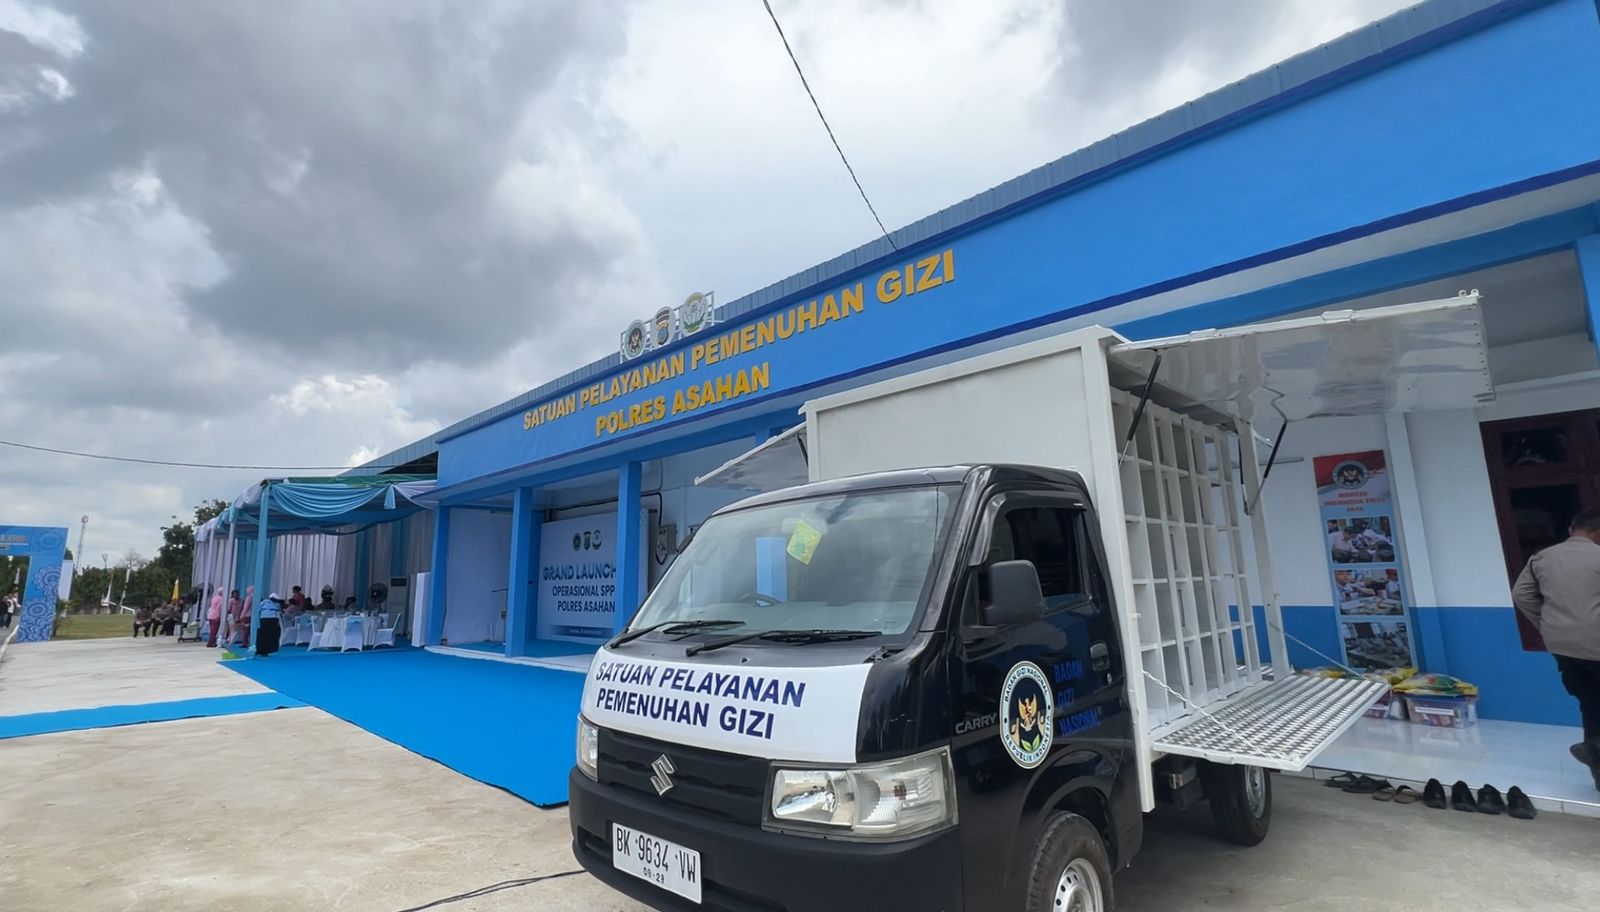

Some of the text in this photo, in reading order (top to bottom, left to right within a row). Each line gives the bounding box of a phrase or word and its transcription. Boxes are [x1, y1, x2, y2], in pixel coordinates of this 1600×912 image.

[523, 393, 577, 431] SATUAN
[580, 351, 685, 410] PELAYANAN
[691, 283, 864, 371] PEMENUHAN
[876, 249, 955, 304] GIZI
[596, 362, 770, 437] POLRES ASAHAN
[543, 564, 575, 581] GRAND
[552, 585, 599, 597] OPERASIONAL
[557, 600, 616, 613] POLRES ASAHAN
[596, 661, 806, 708] SATUAN PELAYANAN
[596, 687, 775, 740] PEMENUHAN GIZI
[955, 713, 997, 734] CARRY
[617, 827, 696, 884] BK 9634 VW
